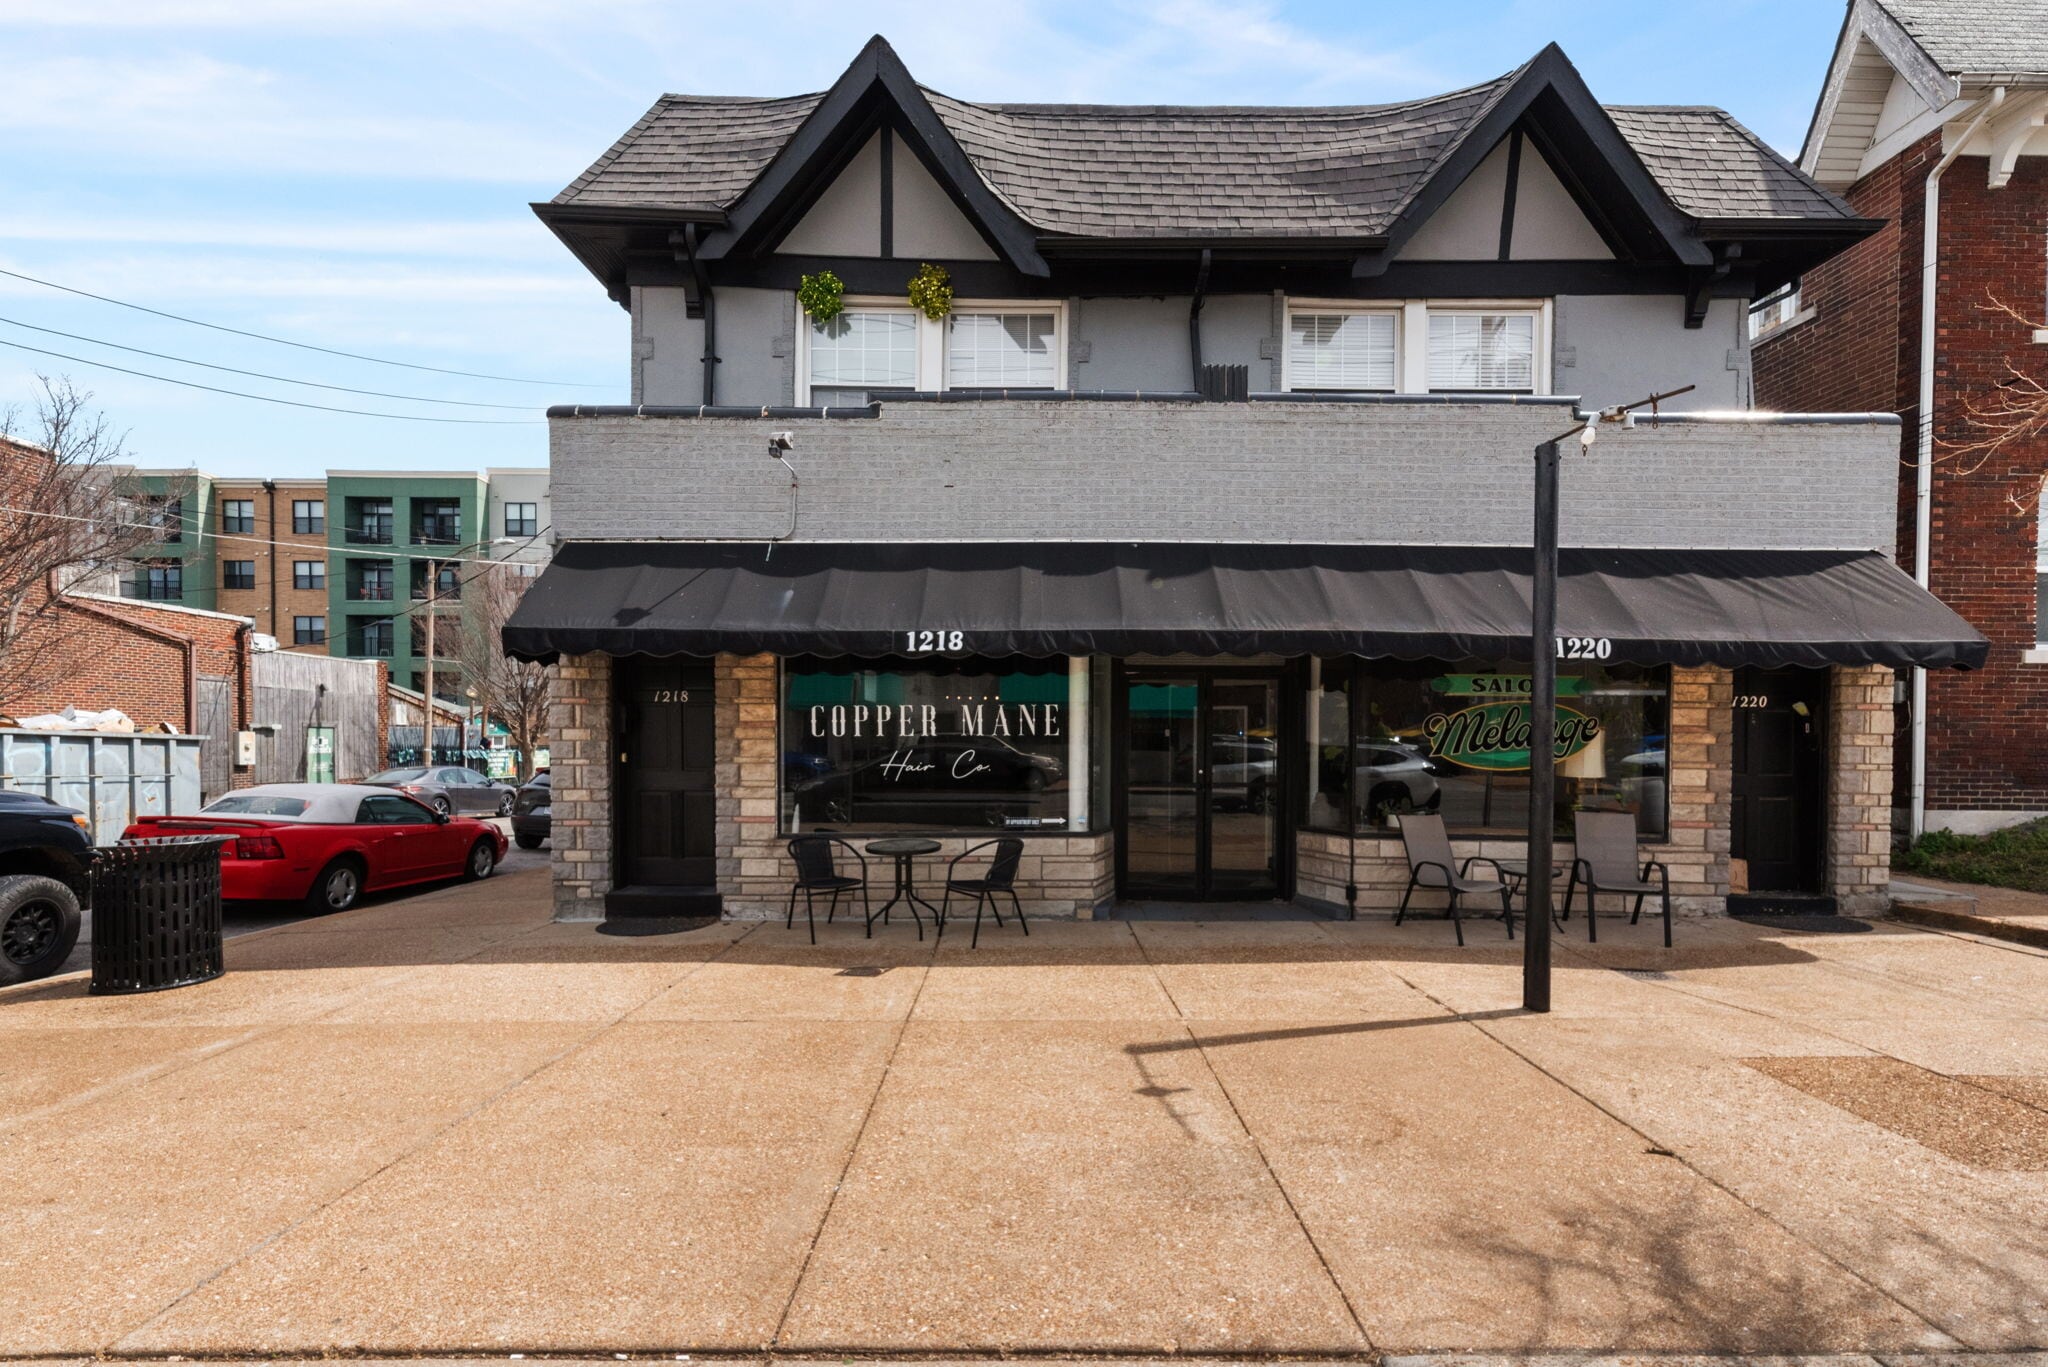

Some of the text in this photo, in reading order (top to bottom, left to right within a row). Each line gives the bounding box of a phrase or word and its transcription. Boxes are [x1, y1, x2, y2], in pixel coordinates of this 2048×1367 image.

[906, 630, 964, 652] 1218
[1555, 637, 1612, 660] 1220
[1471, 677, 1533, 693] SALO
[654, 690, 689, 703] 1218
[1732, 695, 1768, 708] 1220
[811, 704, 1060, 737] COPPER MANE
[880, 749, 992, 782] Hair Co.
